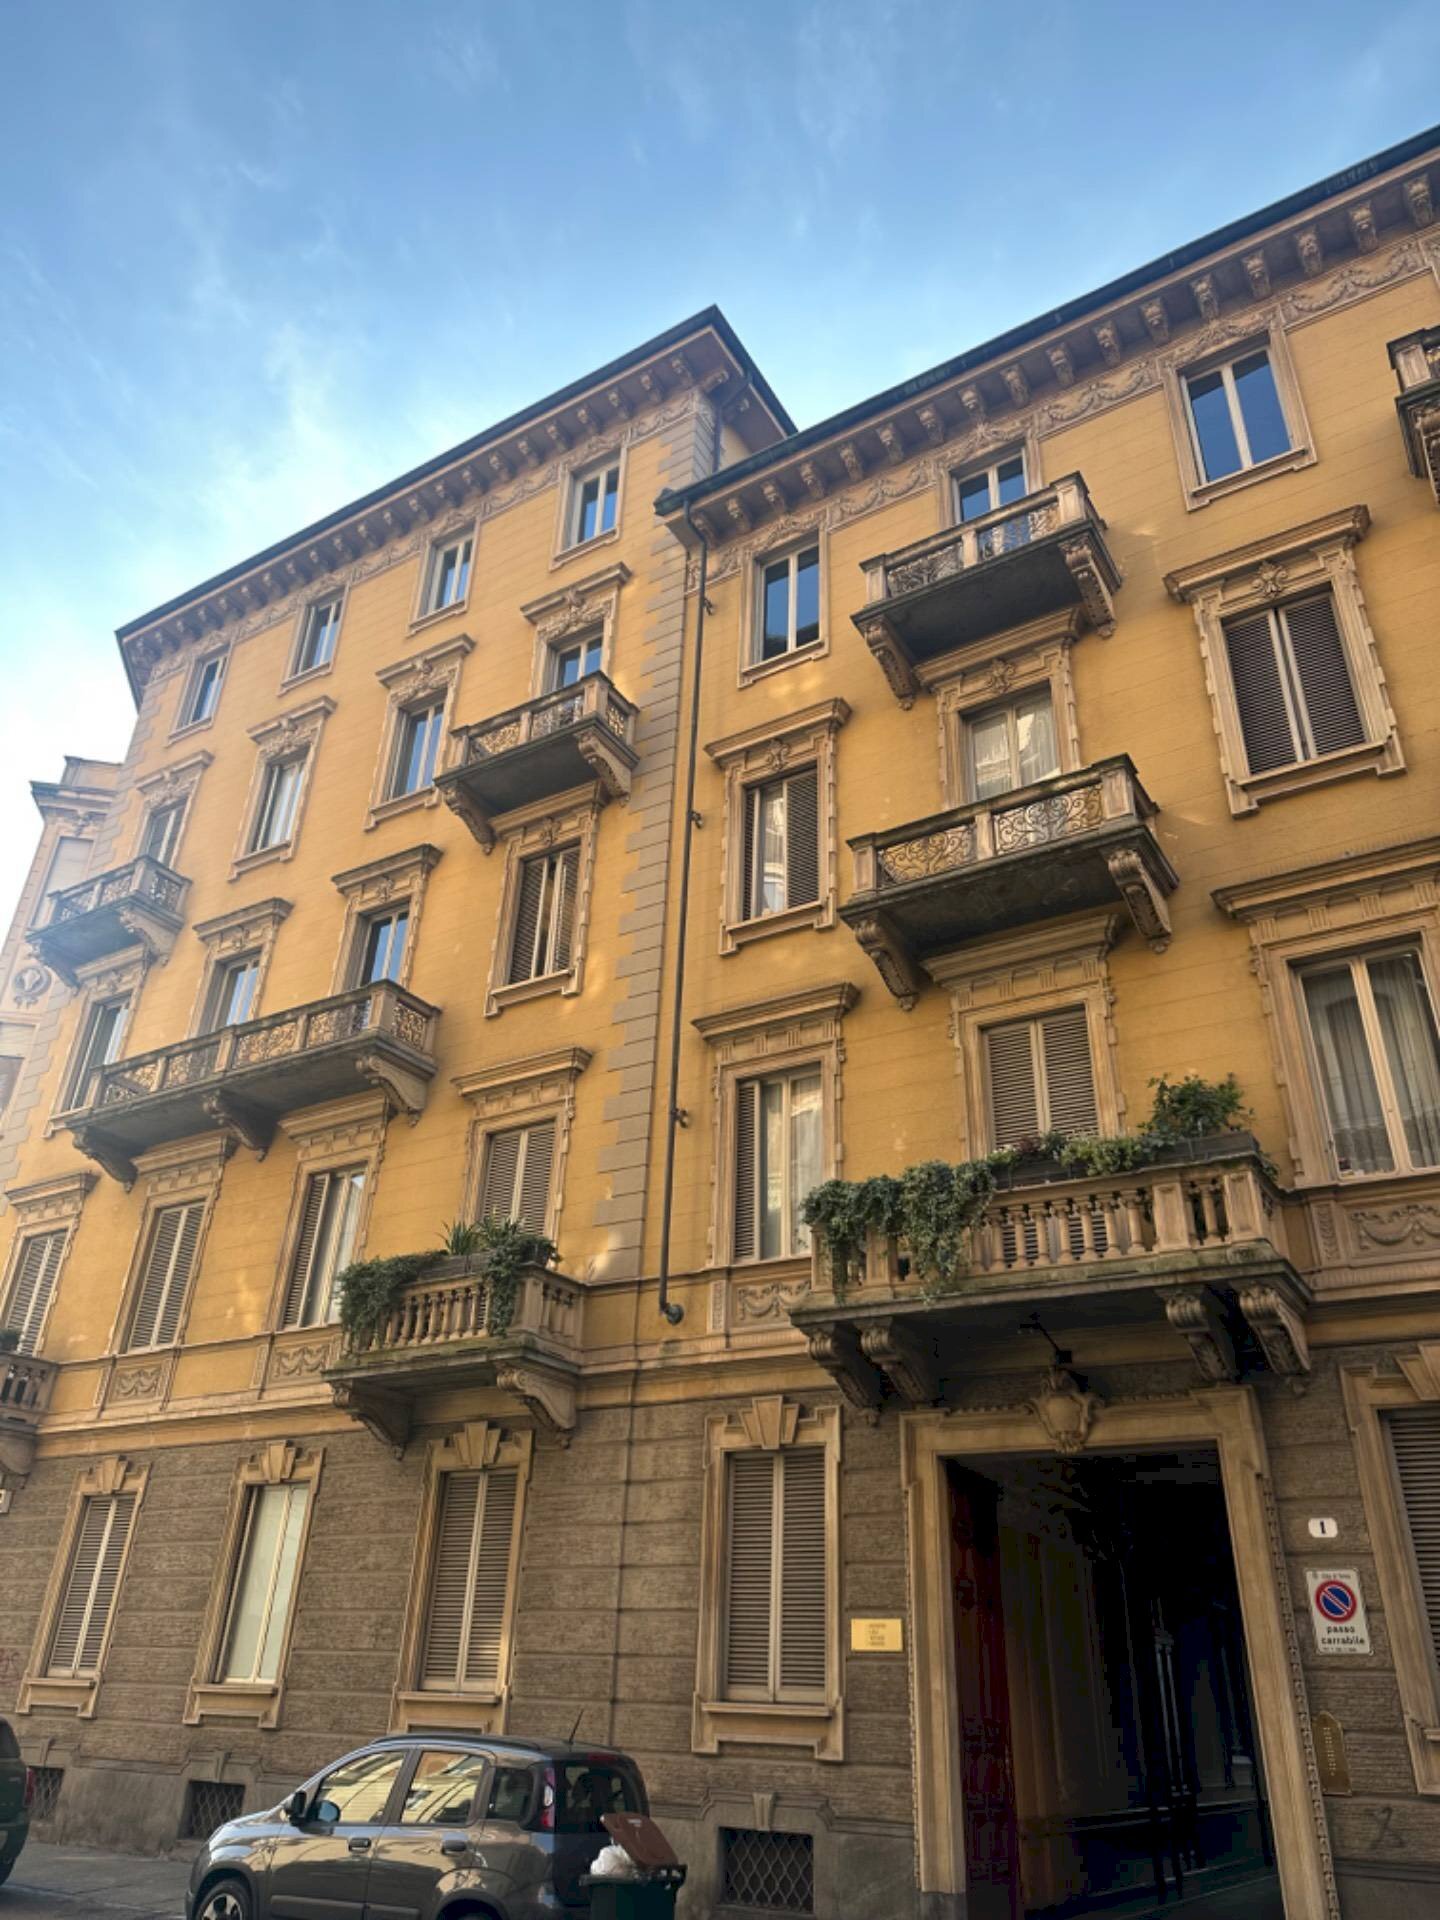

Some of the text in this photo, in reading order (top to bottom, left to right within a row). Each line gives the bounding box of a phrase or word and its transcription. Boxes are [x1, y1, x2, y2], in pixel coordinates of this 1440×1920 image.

[1319, 1520, 1326, 1535] 1
[1327, 1625, 1355, 1634] passo
[1321, 1636, 1365, 1645] carrabile
